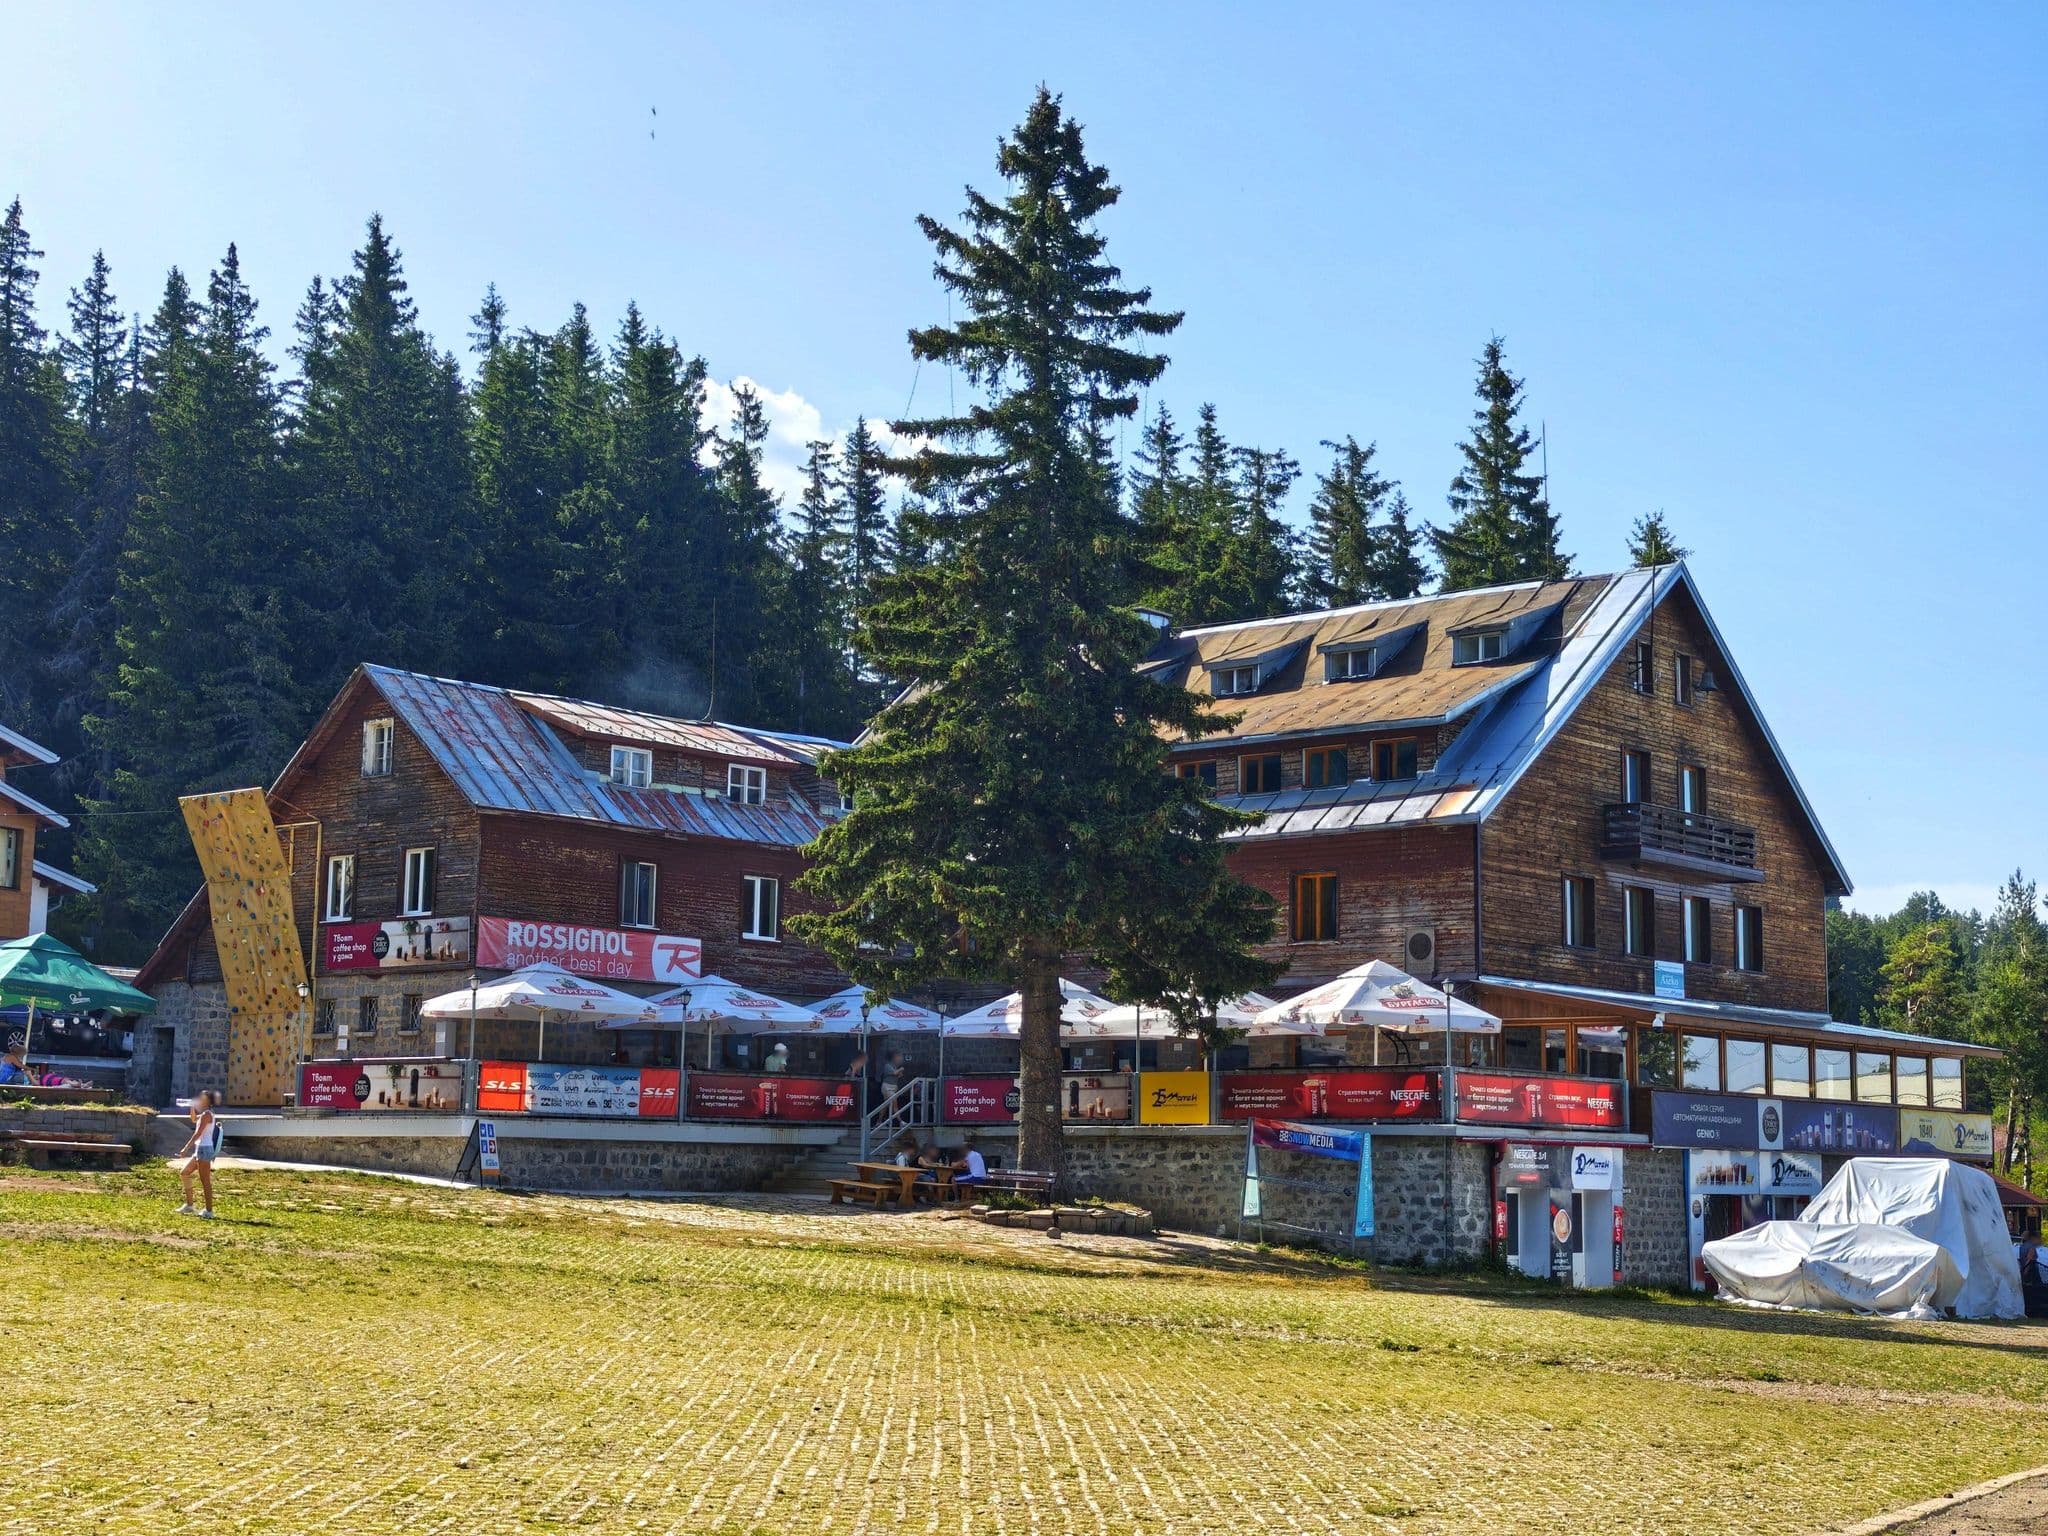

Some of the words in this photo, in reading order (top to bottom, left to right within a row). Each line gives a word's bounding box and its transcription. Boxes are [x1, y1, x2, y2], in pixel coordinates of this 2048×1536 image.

[508, 922, 632, 956] ROSSIGNOL
[332, 944, 352, 952] coffee
[352, 942, 367, 952] shop
[570, 956, 601, 972] best
[606, 958, 632, 978] day
[1388, 998, 1440, 1008] БУРГАСКО
[311, 1084, 330, 1092] coffee
[331, 1084, 346, 1093] shop
[485, 1080, 522, 1090] SLS
[643, 1088, 676, 1096] SLS
[954, 1096, 976, 1104] coffee
[978, 1096, 996, 1106] shop
[1696, 1129, 1714, 1138] GENIO
[1288, 1132, 1334, 1148] SNOWMEDIA
